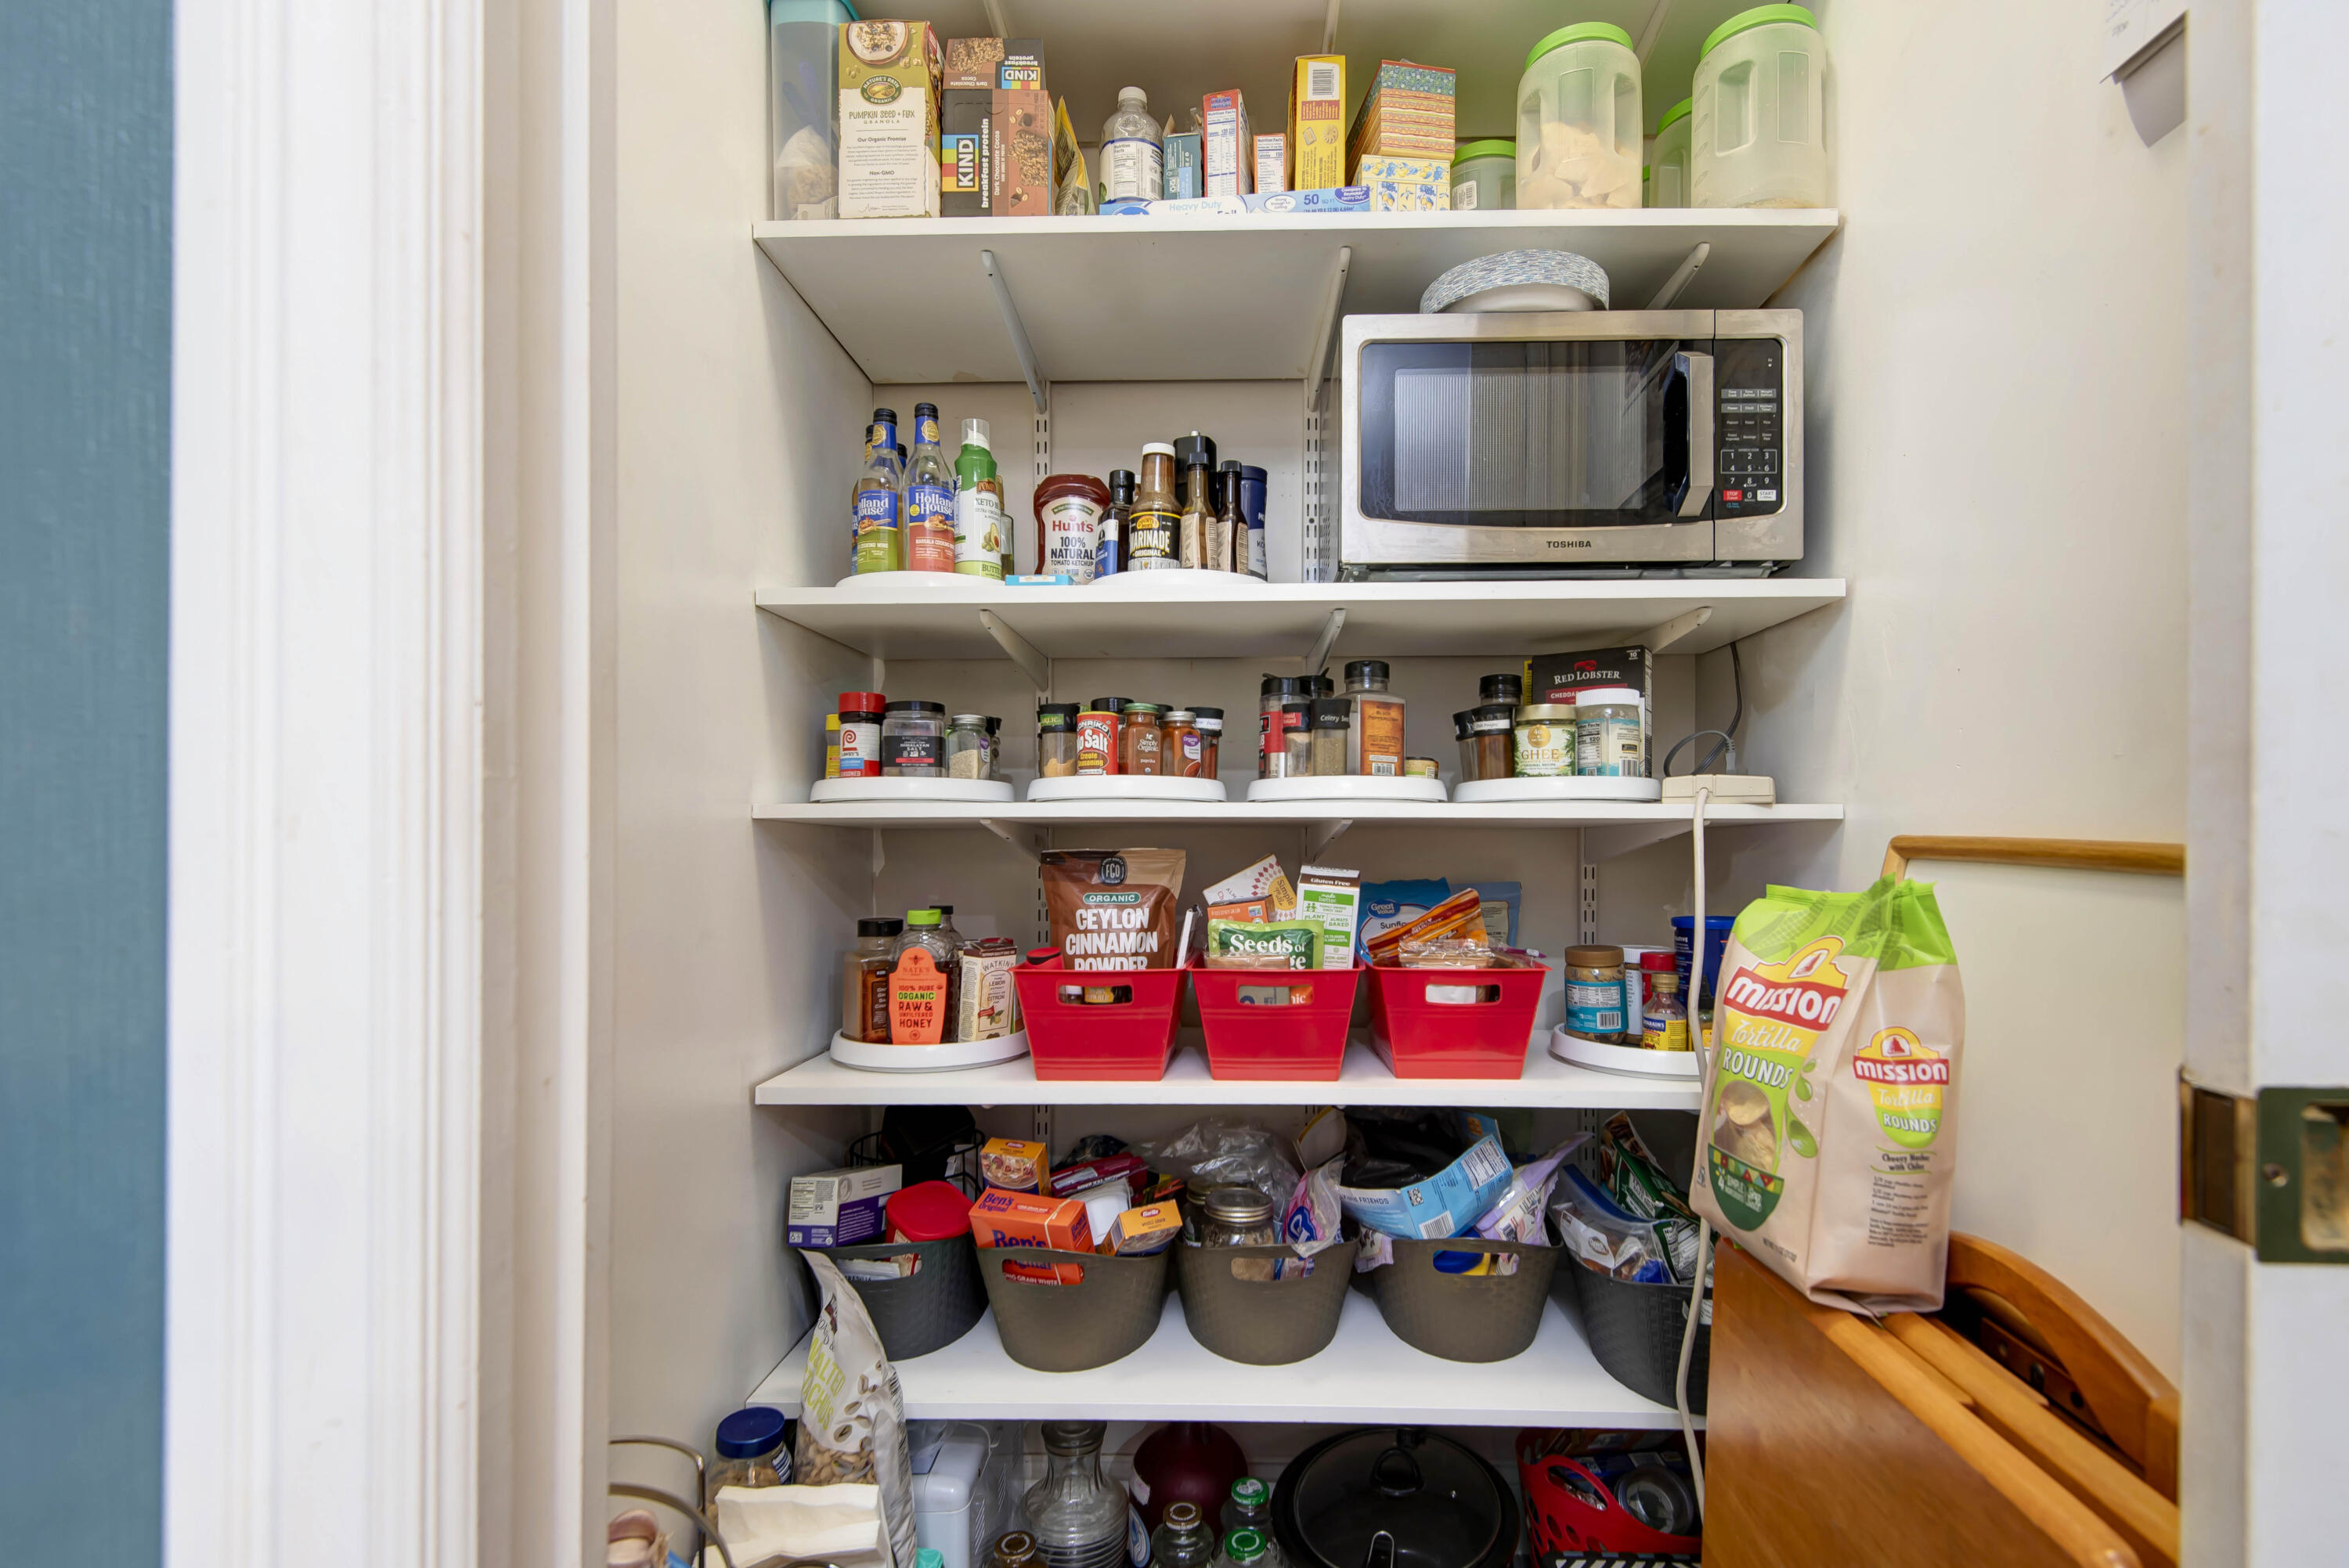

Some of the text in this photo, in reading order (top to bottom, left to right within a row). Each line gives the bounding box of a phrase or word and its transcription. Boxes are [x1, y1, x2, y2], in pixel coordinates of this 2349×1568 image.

[1005, 70, 1037, 81] KIND
[981, 118, 990, 156] protein
[958, 139, 974, 186] KIND
[1169, 200, 1221, 211] Heavy Duty
[1304, 193, 1319, 205] 50
[976, 498, 994, 508] KETO
[1052, 519, 1094, 532] Hunt's
[1060, 536, 1086, 548] 100%
[1051, 548, 1095, 560] NATURAL
[1135, 549, 1162, 557] ORIGINAL
[1553, 670, 1621, 684] RED LOBSTER
[1320, 715, 1340, 723] Celery
[1084, 729, 1109, 753] Salt
[1521, 749, 1560, 759] GHEE
[1277, 879, 1293, 906] Simple
[1076, 908, 1149, 931] CEYLON
[1066, 932, 1158, 955] CINNAMON
[1229, 934, 1307, 953] Seeds of
[898, 992, 934, 1000] ORGANIC
[1727, 976, 1842, 1024] MISSION
[898, 1002, 933, 1011] RAW &
[899, 1019, 932, 1028] HONEY
[1731, 1019, 1802, 1052] Tortilla
[1723, 1047, 1795, 1090] ROUNDS
[1855, 1060, 1947, 1082] MISSION
[1878, 1088, 1934, 1107] Tortilla
[1882, 1112, 1937, 1134] ROUNDS
[983, 1193, 1015, 1206] Ben's
[979, 1203, 1009, 1213] Original
[991, 1229, 1047, 1248] Ben's
[1017, 1274, 1037, 1284] GRAIN
